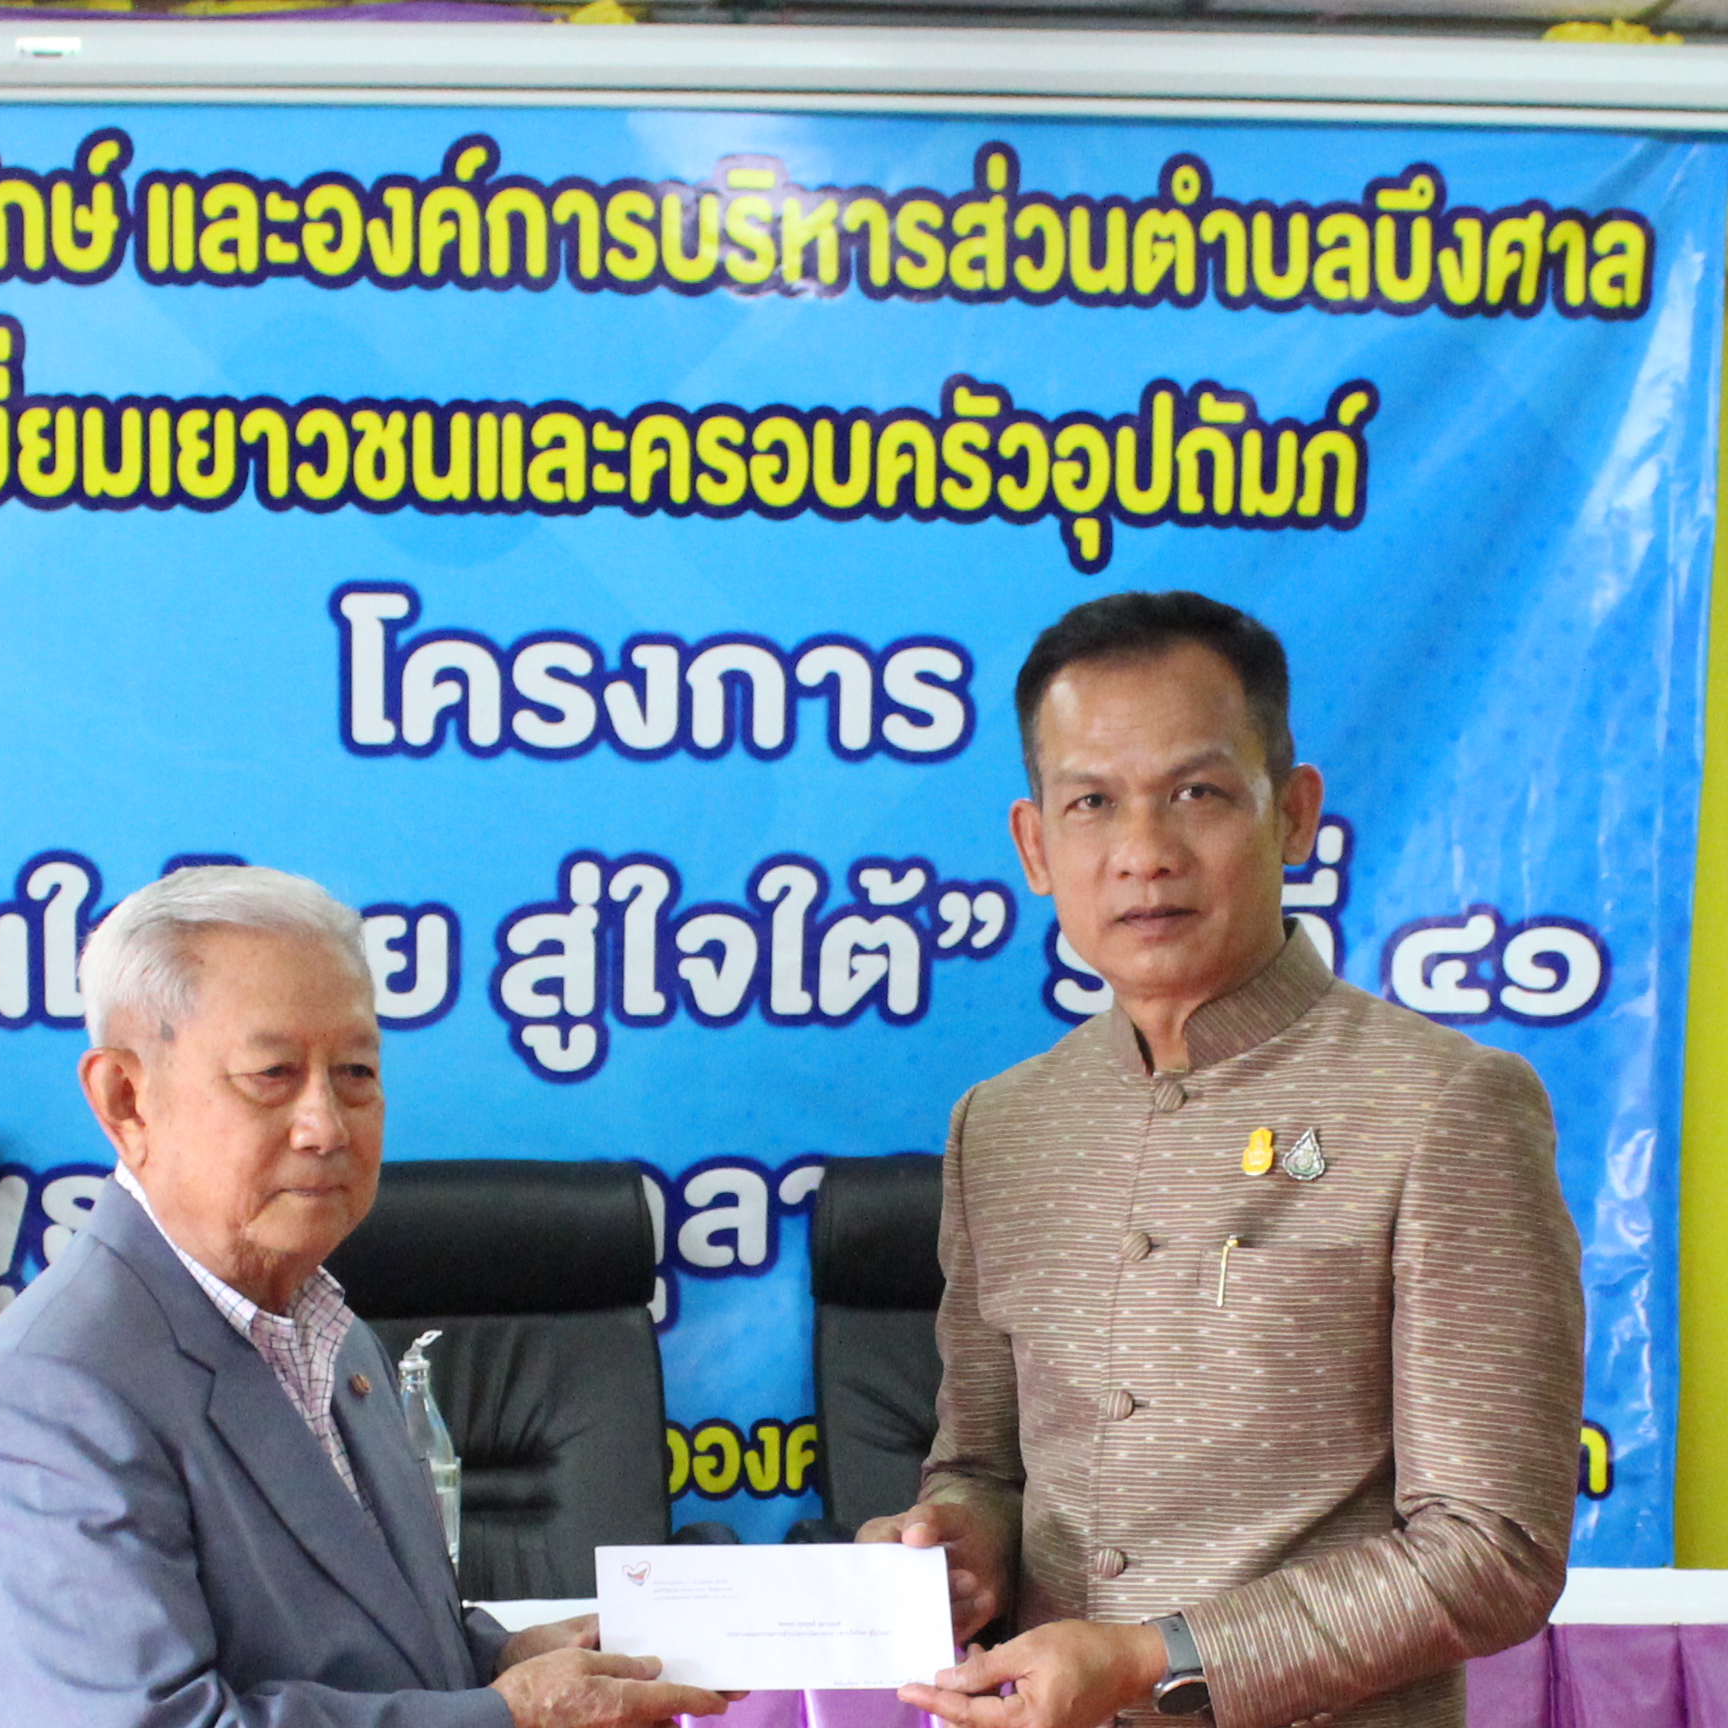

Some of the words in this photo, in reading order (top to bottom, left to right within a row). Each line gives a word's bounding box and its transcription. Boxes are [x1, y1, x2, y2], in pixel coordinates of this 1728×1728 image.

[145, 143, 1648, 309] และองค์การบริหารส่วนตำบลบึงศาล
[338, 591, 966, 752] โครงการ
[499, 860, 1007, 1073] สู่ใจใต้”
[1389, 912, 1602, 1018] ๔๑
